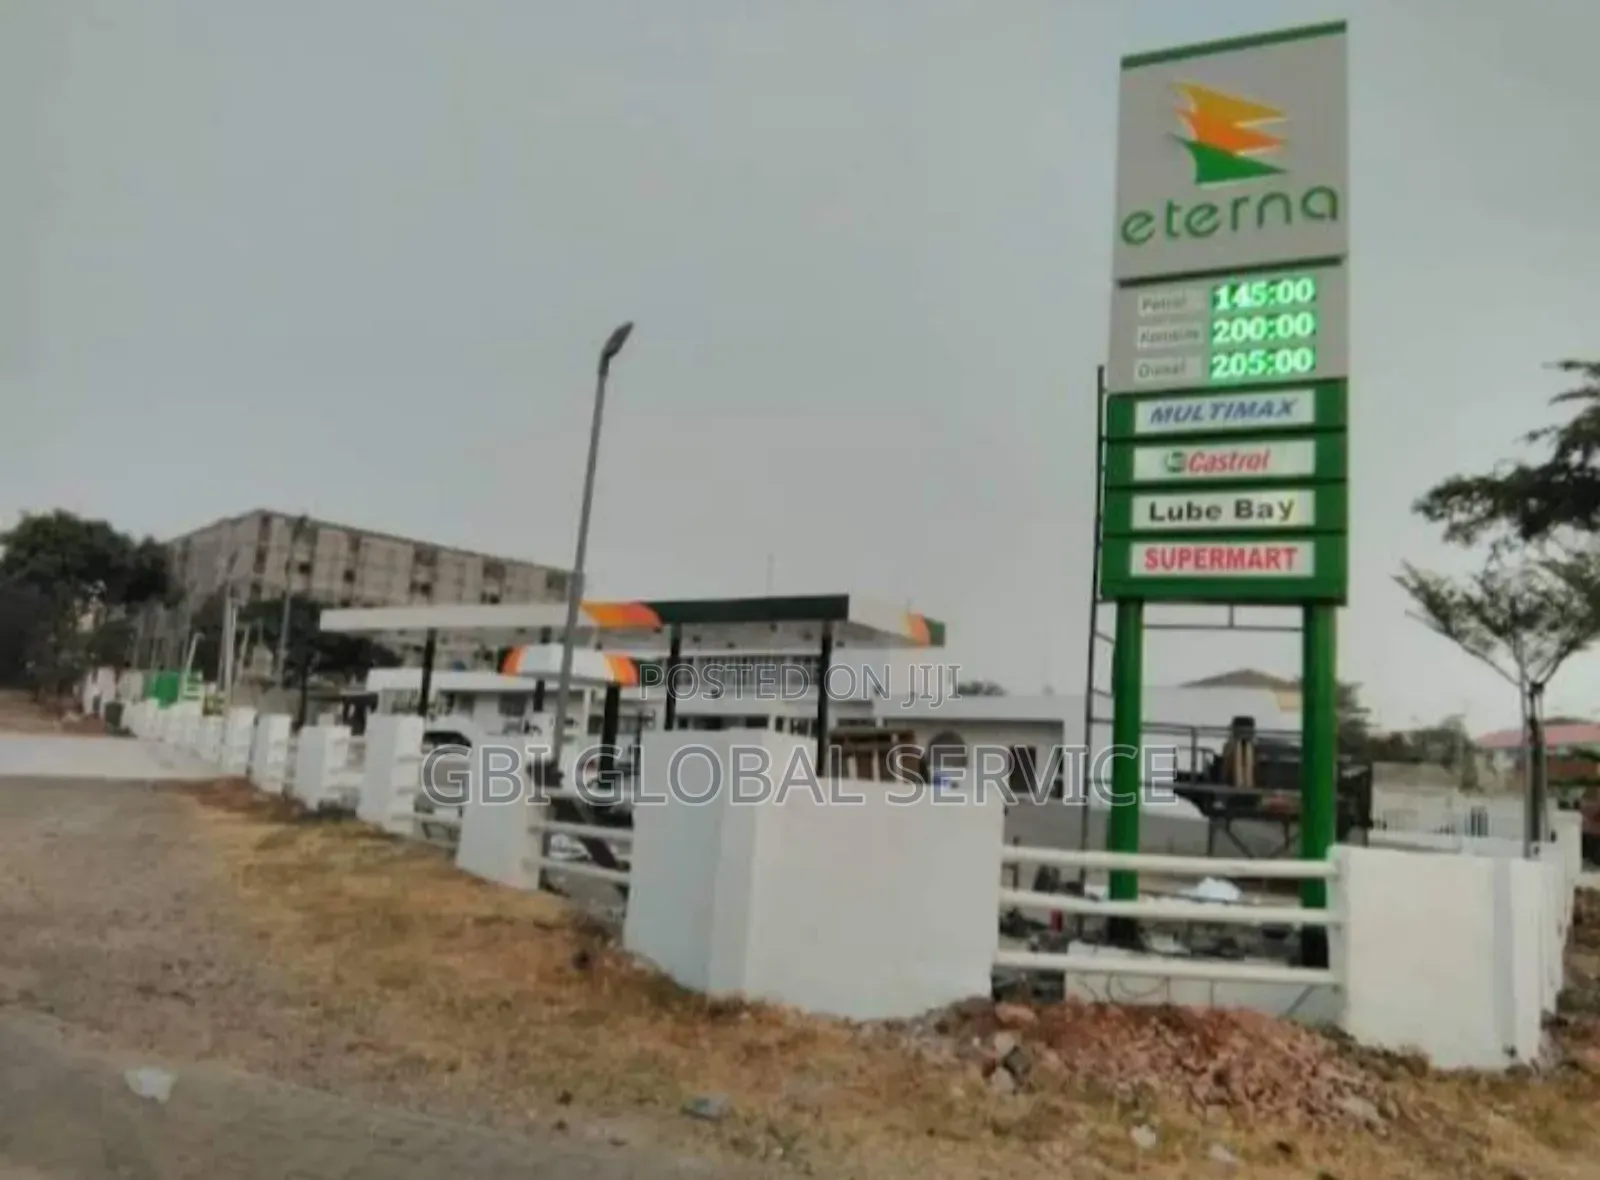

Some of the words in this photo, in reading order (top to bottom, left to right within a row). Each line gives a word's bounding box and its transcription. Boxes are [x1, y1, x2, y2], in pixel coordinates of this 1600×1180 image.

[1120, 185, 1339, 245] eterna
[1150, 398, 1297, 424] MULTIMAX
[1189, 449, 1270, 473] Castrol
[1149, 501, 1223, 523] Lube
[1234, 499, 1296, 522] Bay
[1144, 546, 1299, 571] SUPERMART
